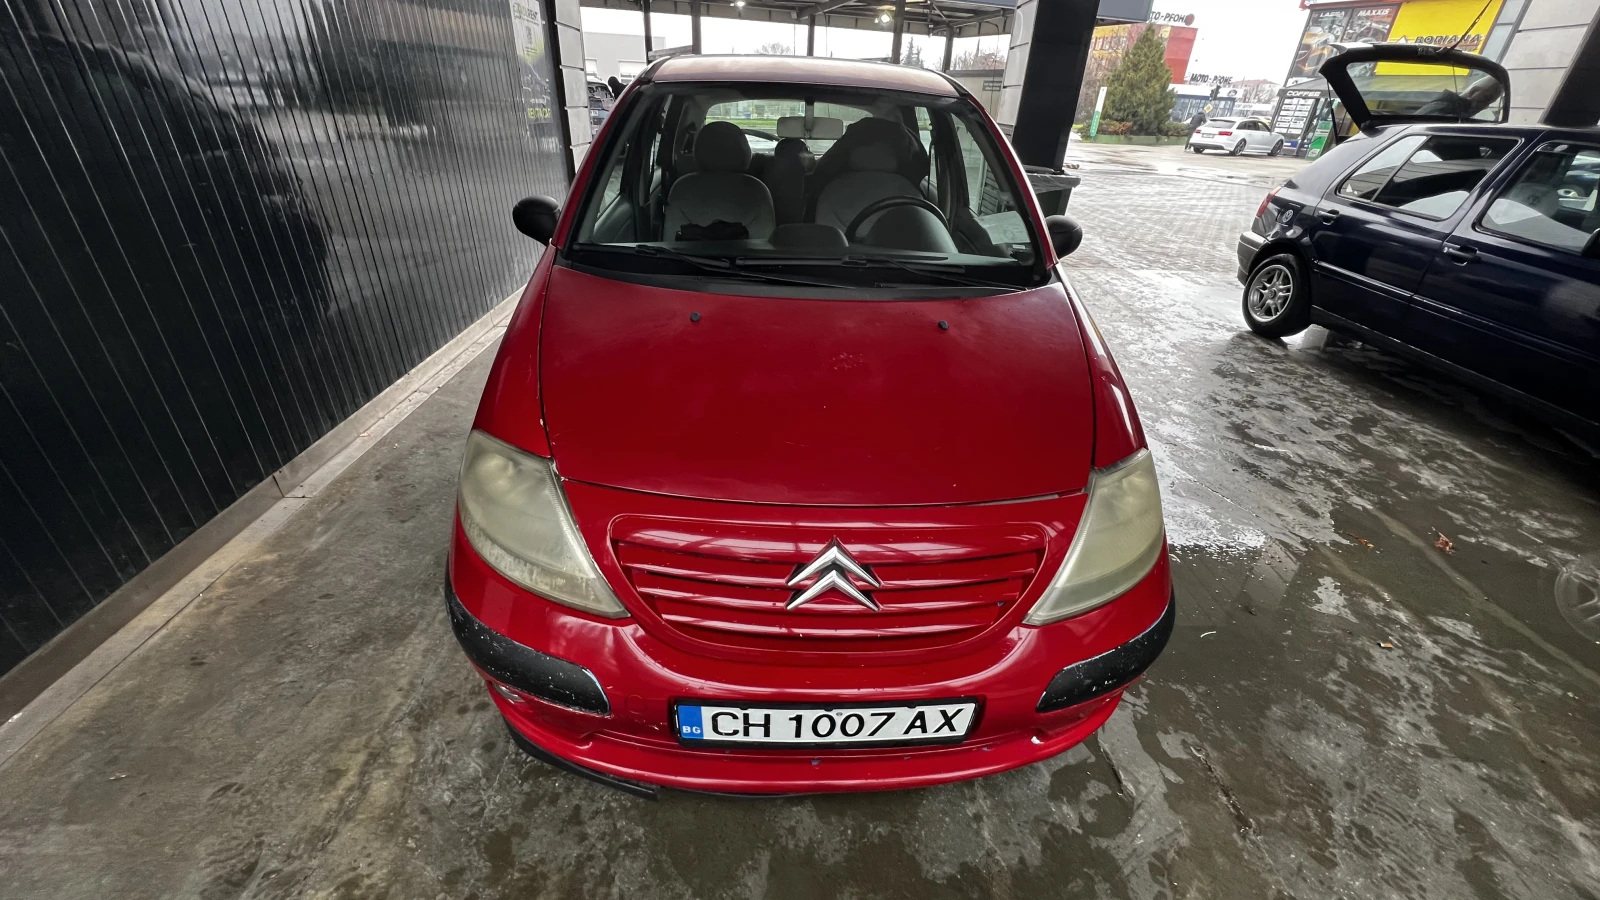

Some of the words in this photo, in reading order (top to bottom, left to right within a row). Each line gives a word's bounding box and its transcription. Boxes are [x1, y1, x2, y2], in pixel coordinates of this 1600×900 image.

[1357, 8, 1390, 17] MAXXIS
[711, 711, 771, 738] CH
[788, 711, 896, 739] 1007
[902, 707, 965, 735] AX
[682, 725, 702, 734] BG
